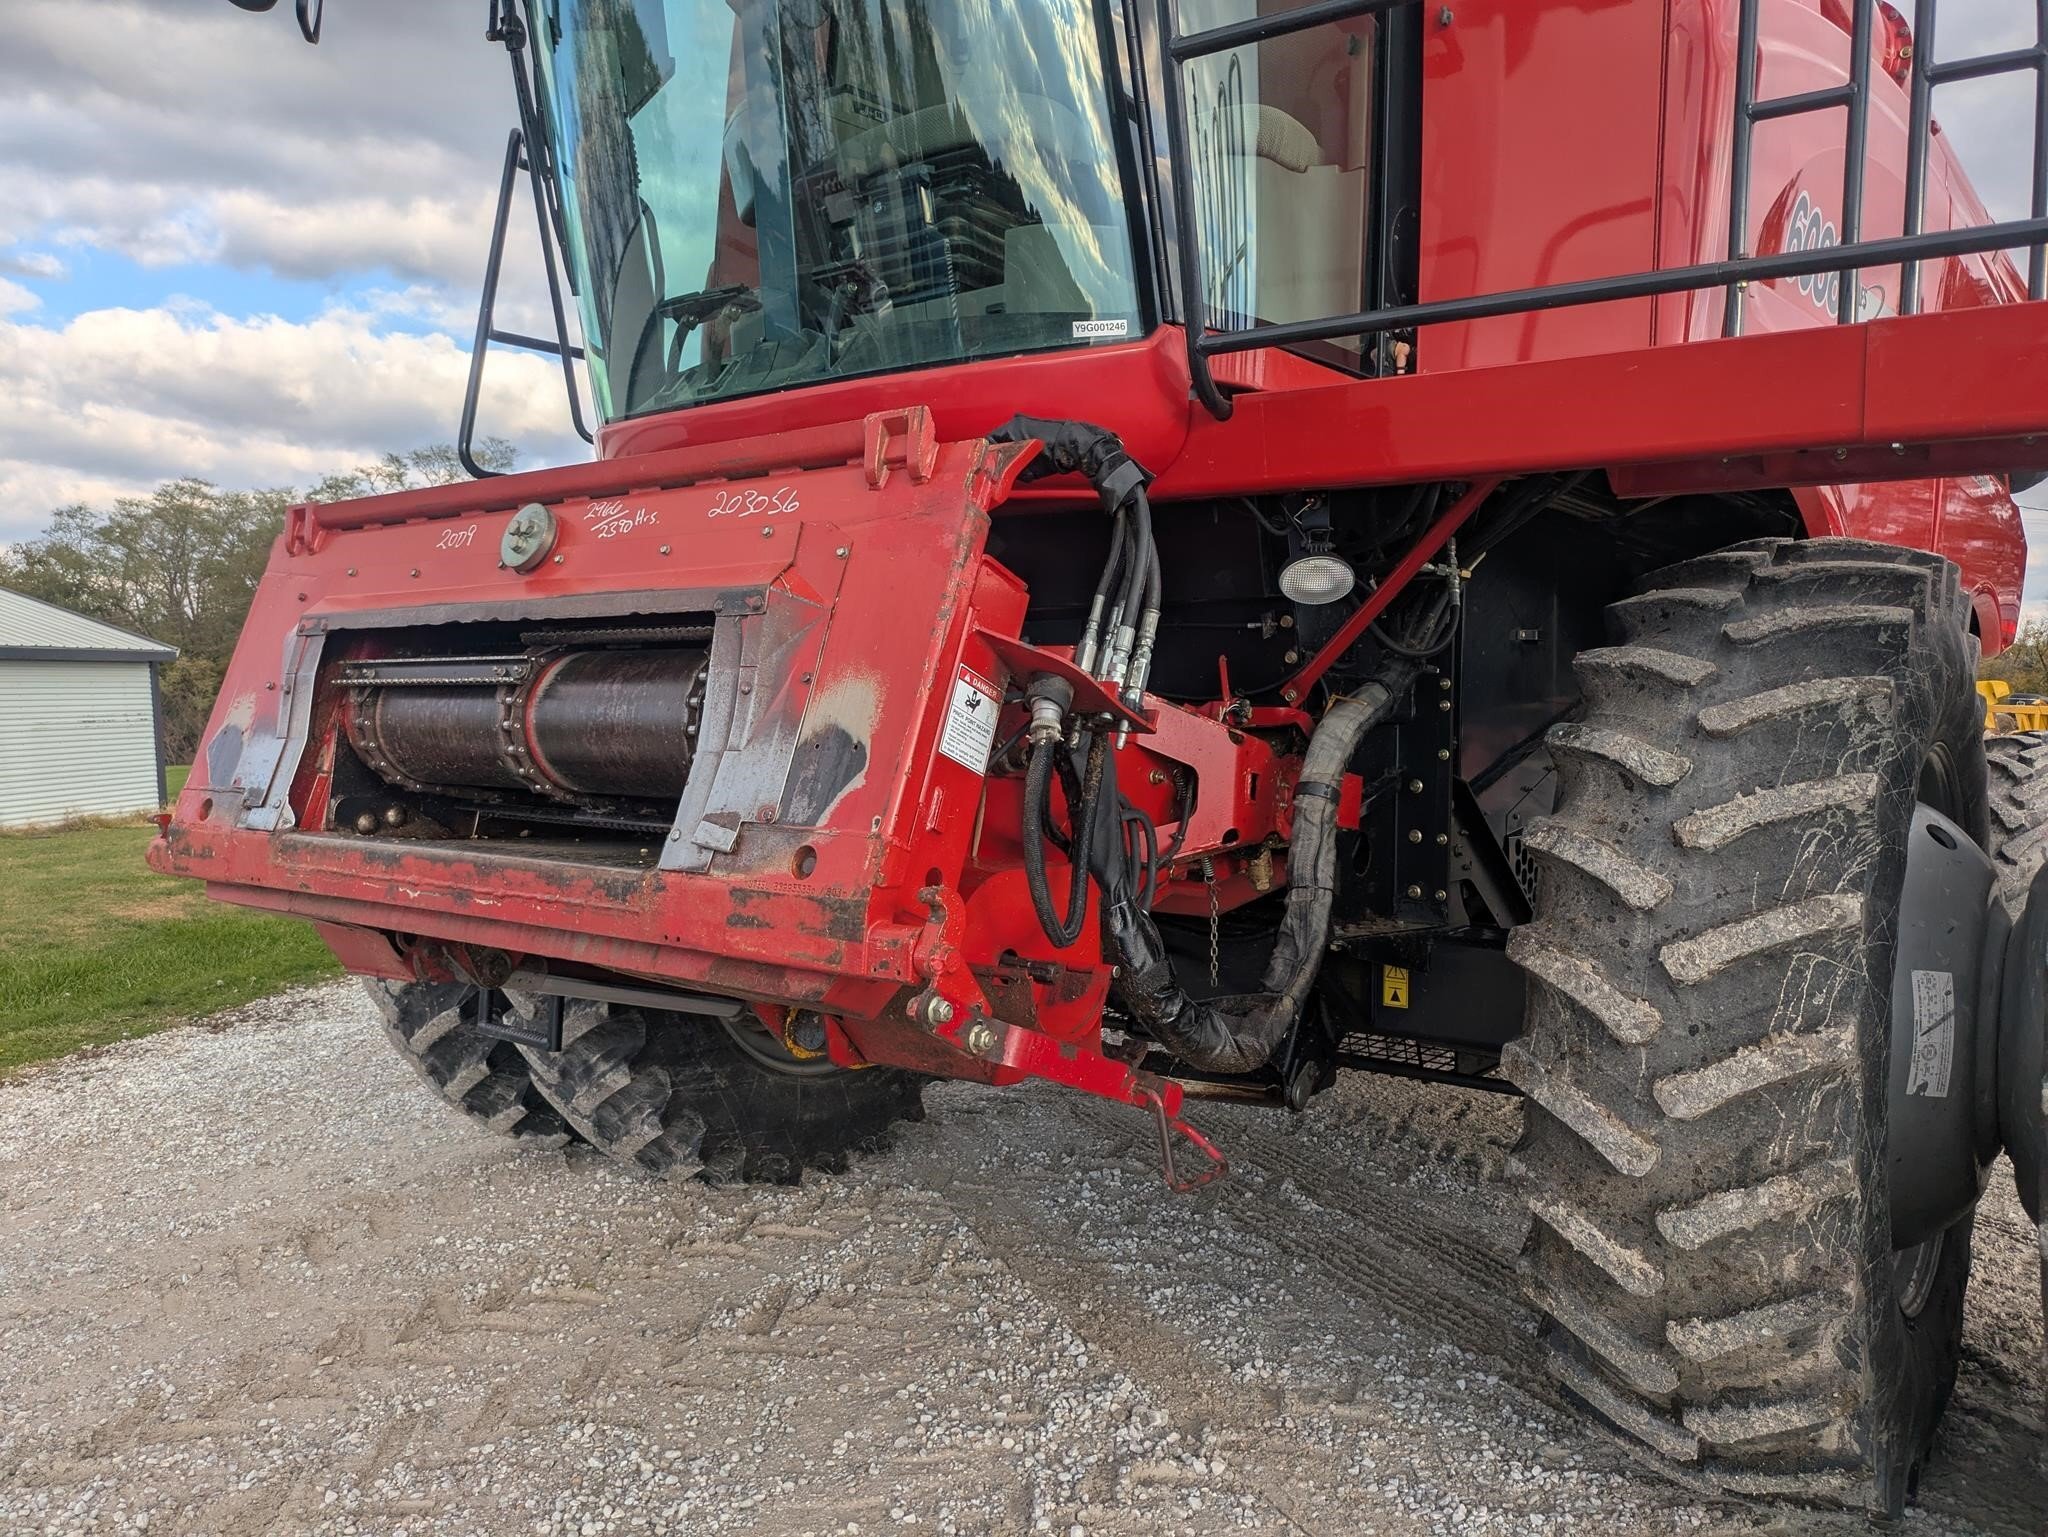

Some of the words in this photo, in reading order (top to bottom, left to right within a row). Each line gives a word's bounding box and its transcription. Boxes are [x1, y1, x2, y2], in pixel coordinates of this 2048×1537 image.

[1786, 190, 1840, 318] 608
[1075, 322, 1125, 332] Y9G001246
[708, 486, 800, 518] 203056
[635, 508, 660, 526] Hrs.
[436, 524, 477, 549] 2009
[972, 679, 997, 698] DANGER
